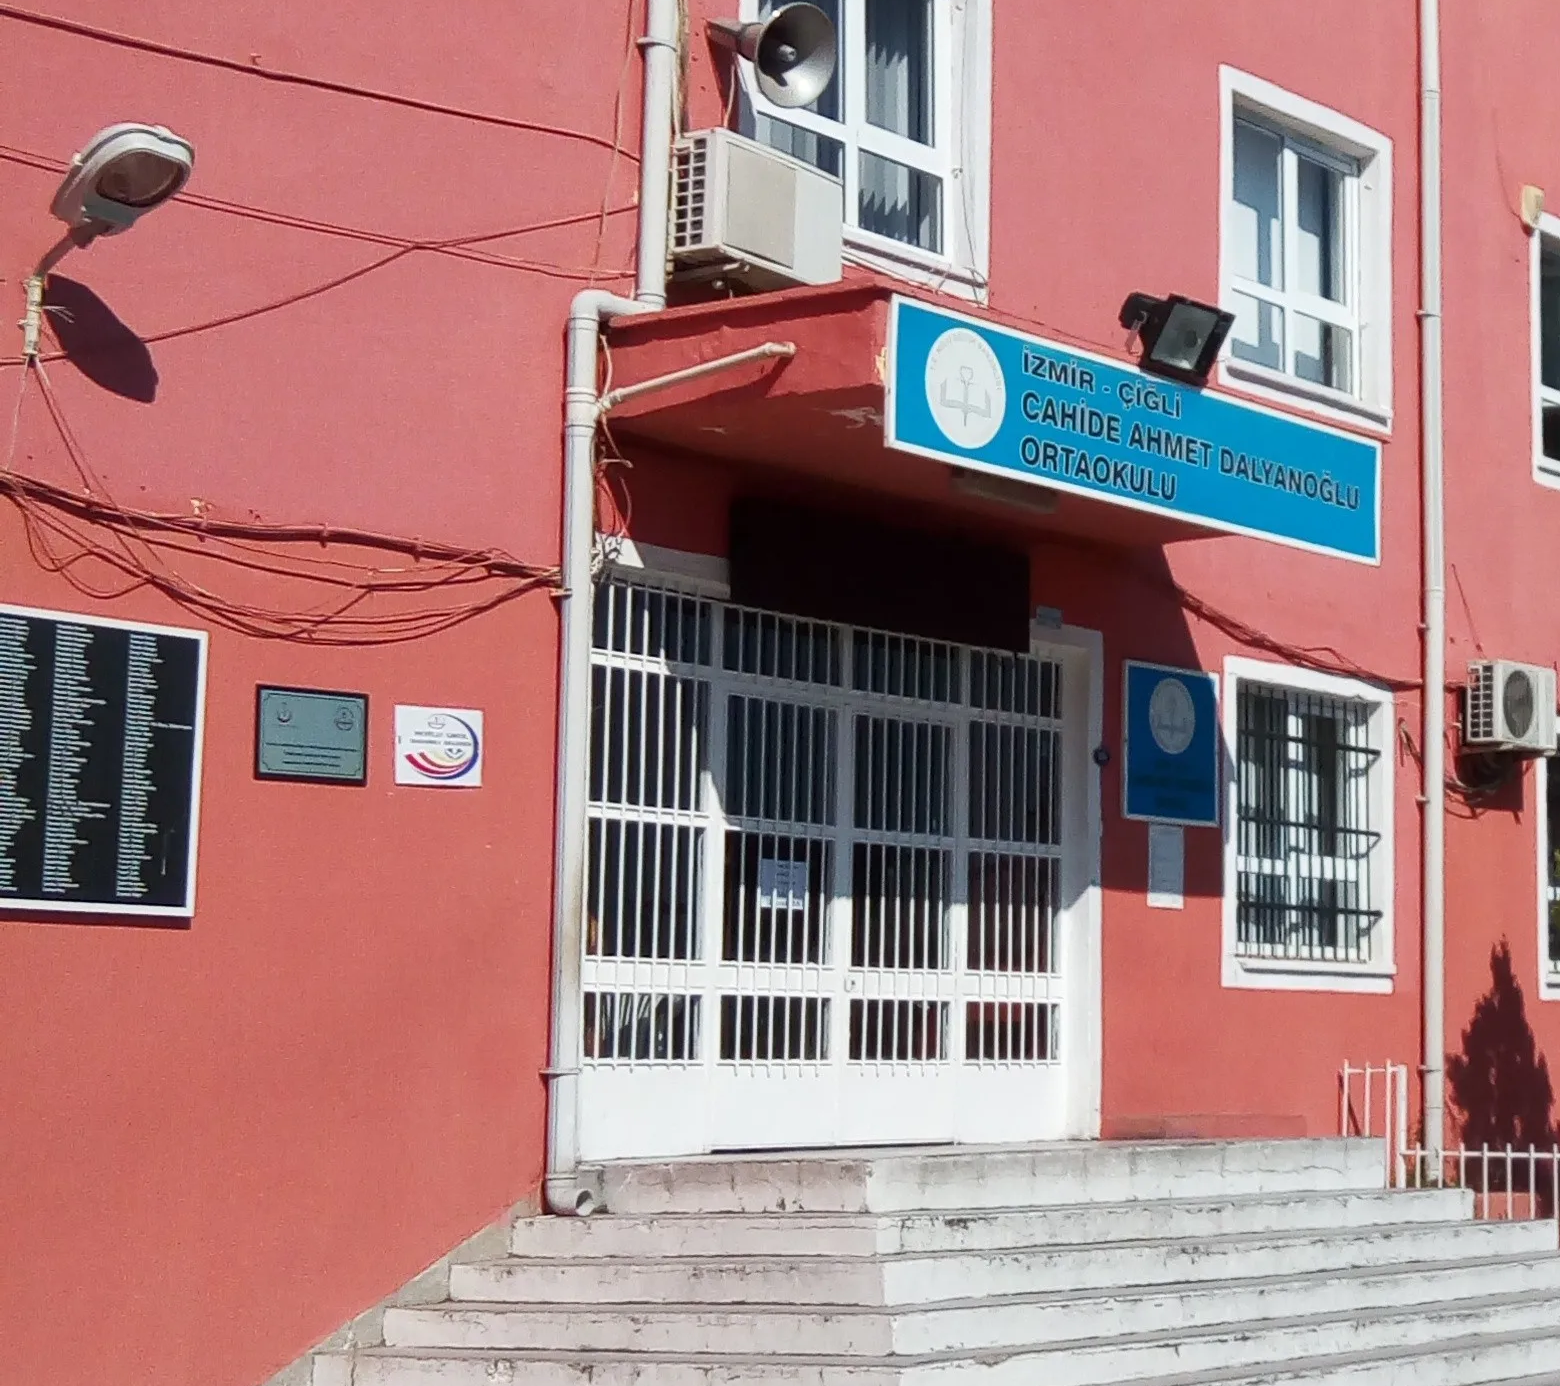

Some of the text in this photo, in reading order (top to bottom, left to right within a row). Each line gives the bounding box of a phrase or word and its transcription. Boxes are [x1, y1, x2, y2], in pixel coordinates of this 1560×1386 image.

[1021, 345, 1095, 394] İZMİR
[1117, 379, 1182, 419] ÇİĞLİ
[1020, 435, 1177, 502] ORTAOKULU
[1021, 390, 1360, 511] CAHİDE AHMET DALYANOĞLU
